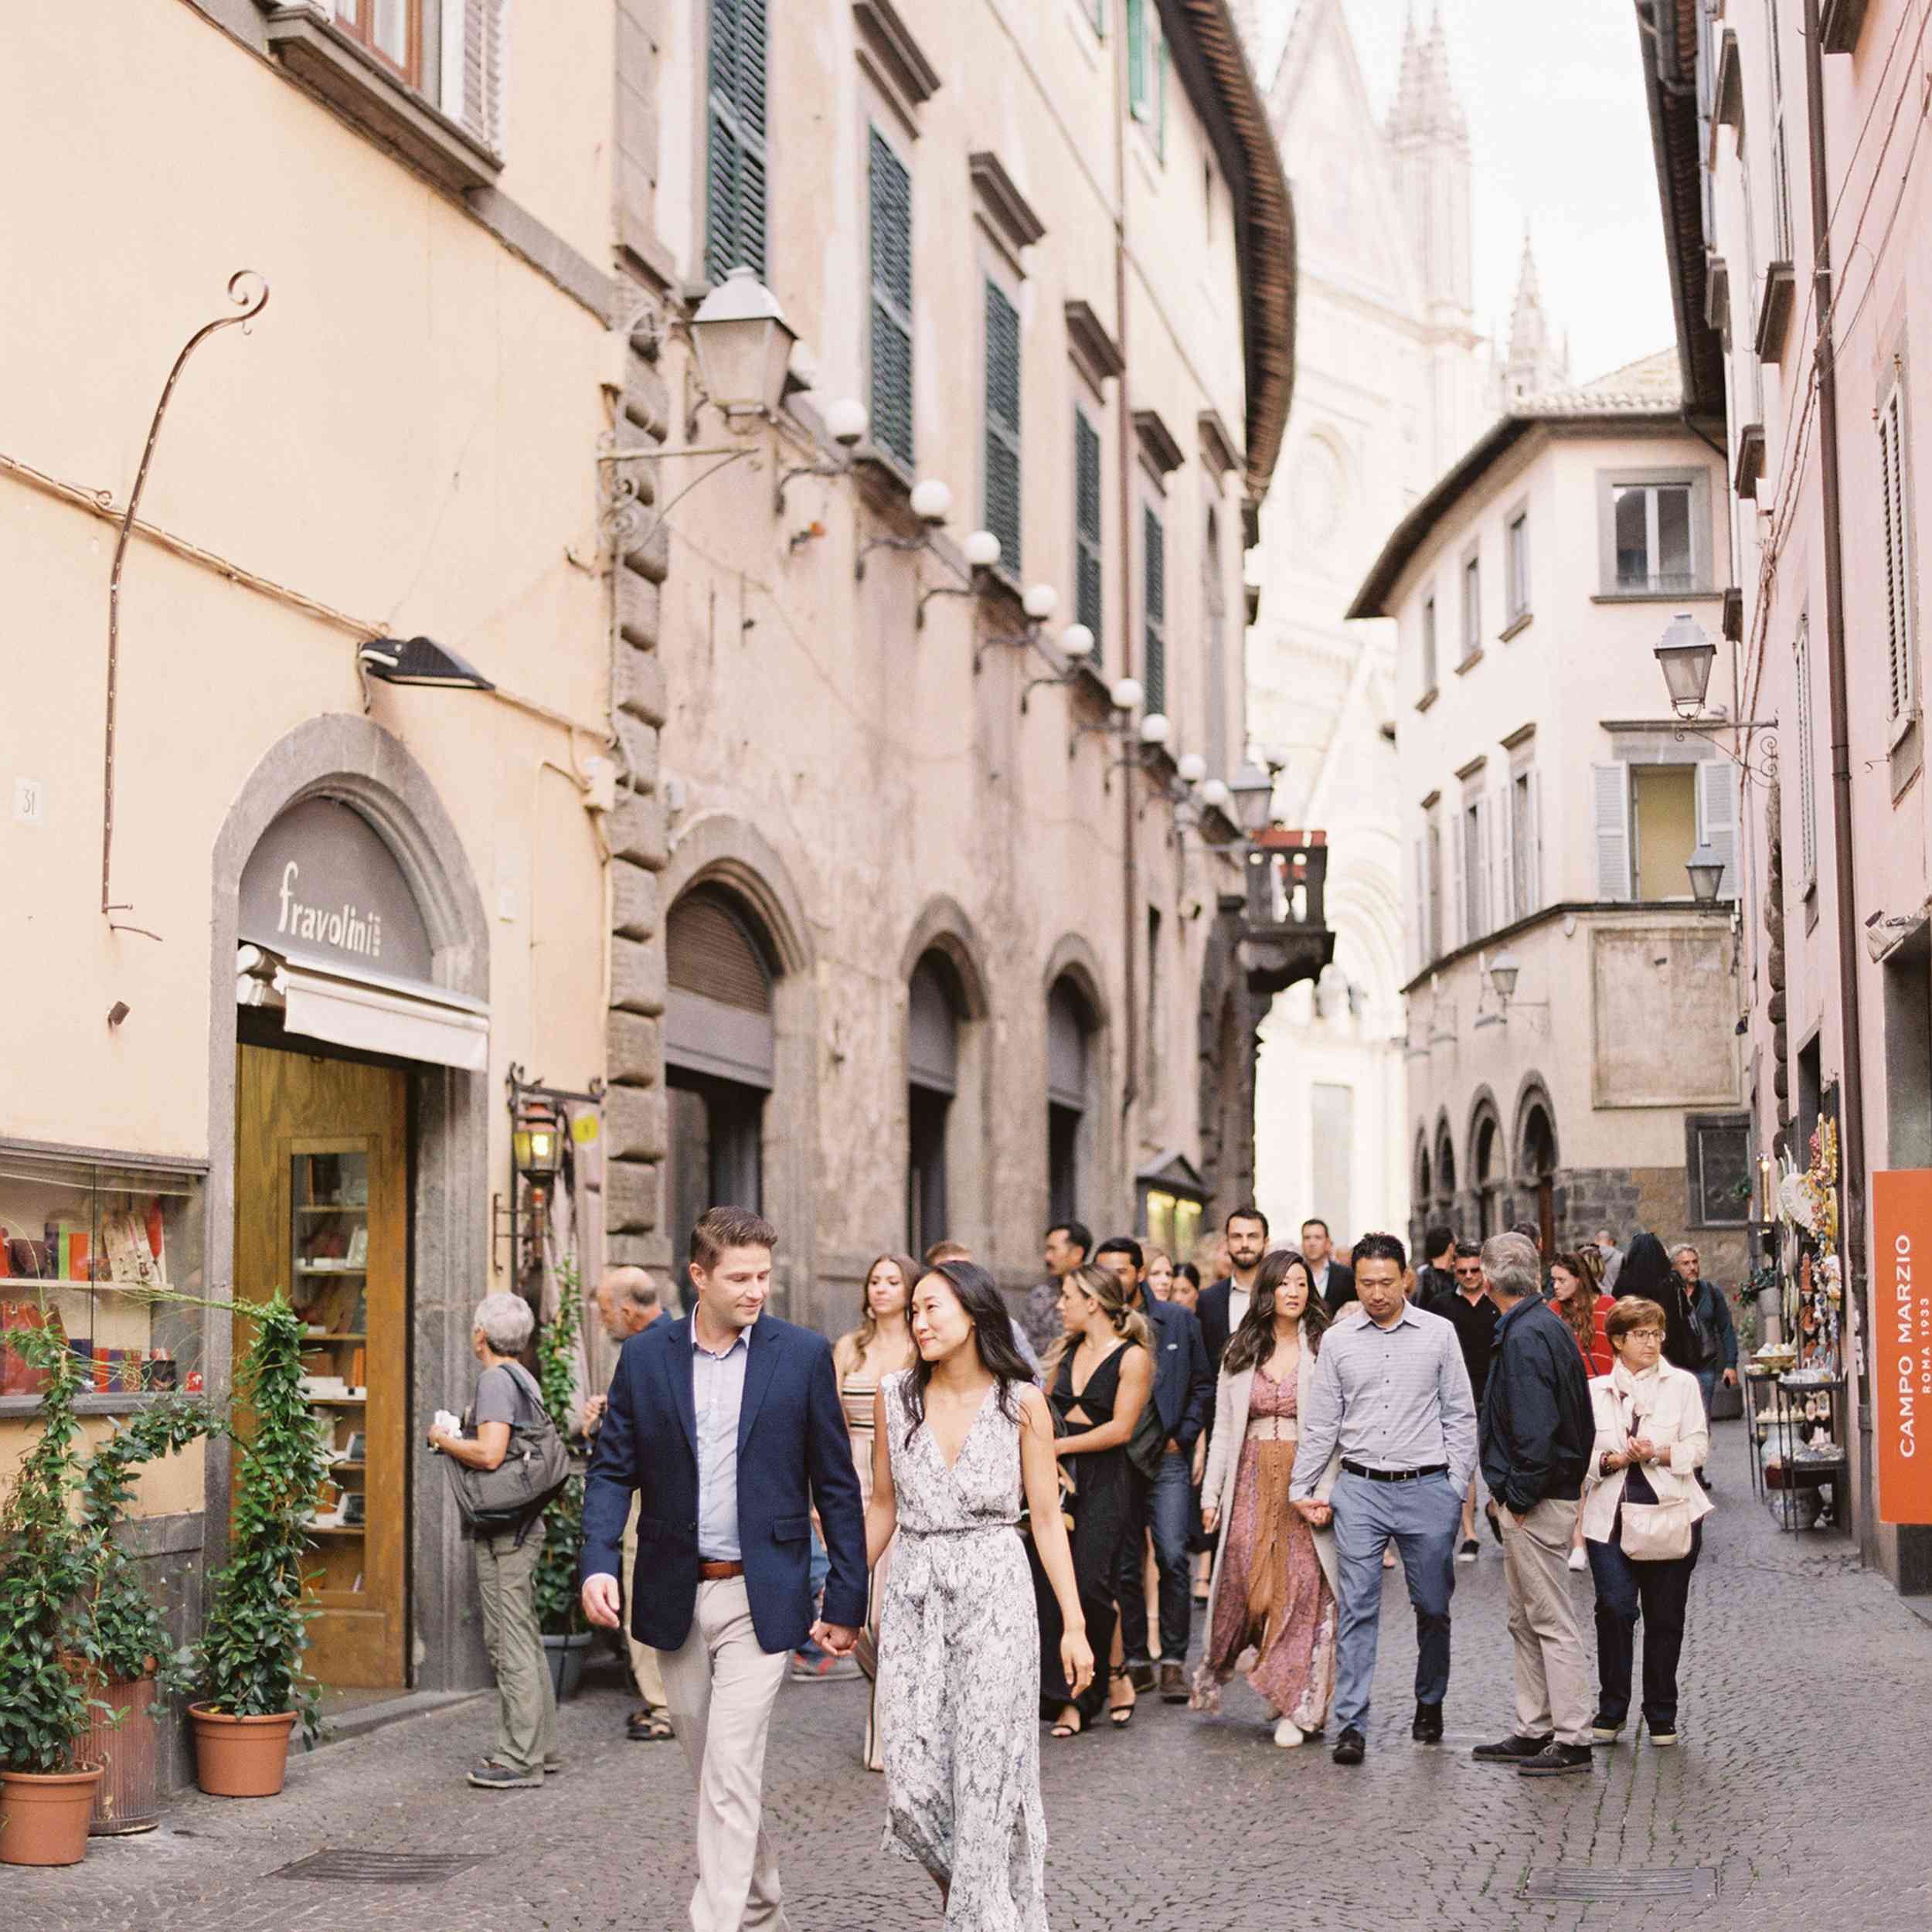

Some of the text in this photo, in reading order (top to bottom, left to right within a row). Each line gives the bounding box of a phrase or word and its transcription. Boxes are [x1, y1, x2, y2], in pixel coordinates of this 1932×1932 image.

[277, 860, 373, 955] fravolini
[1895, 1234, 1915, 1458] CAMPO MARZIO
[1920, 1298, 1931, 1394] ROMA 1933
